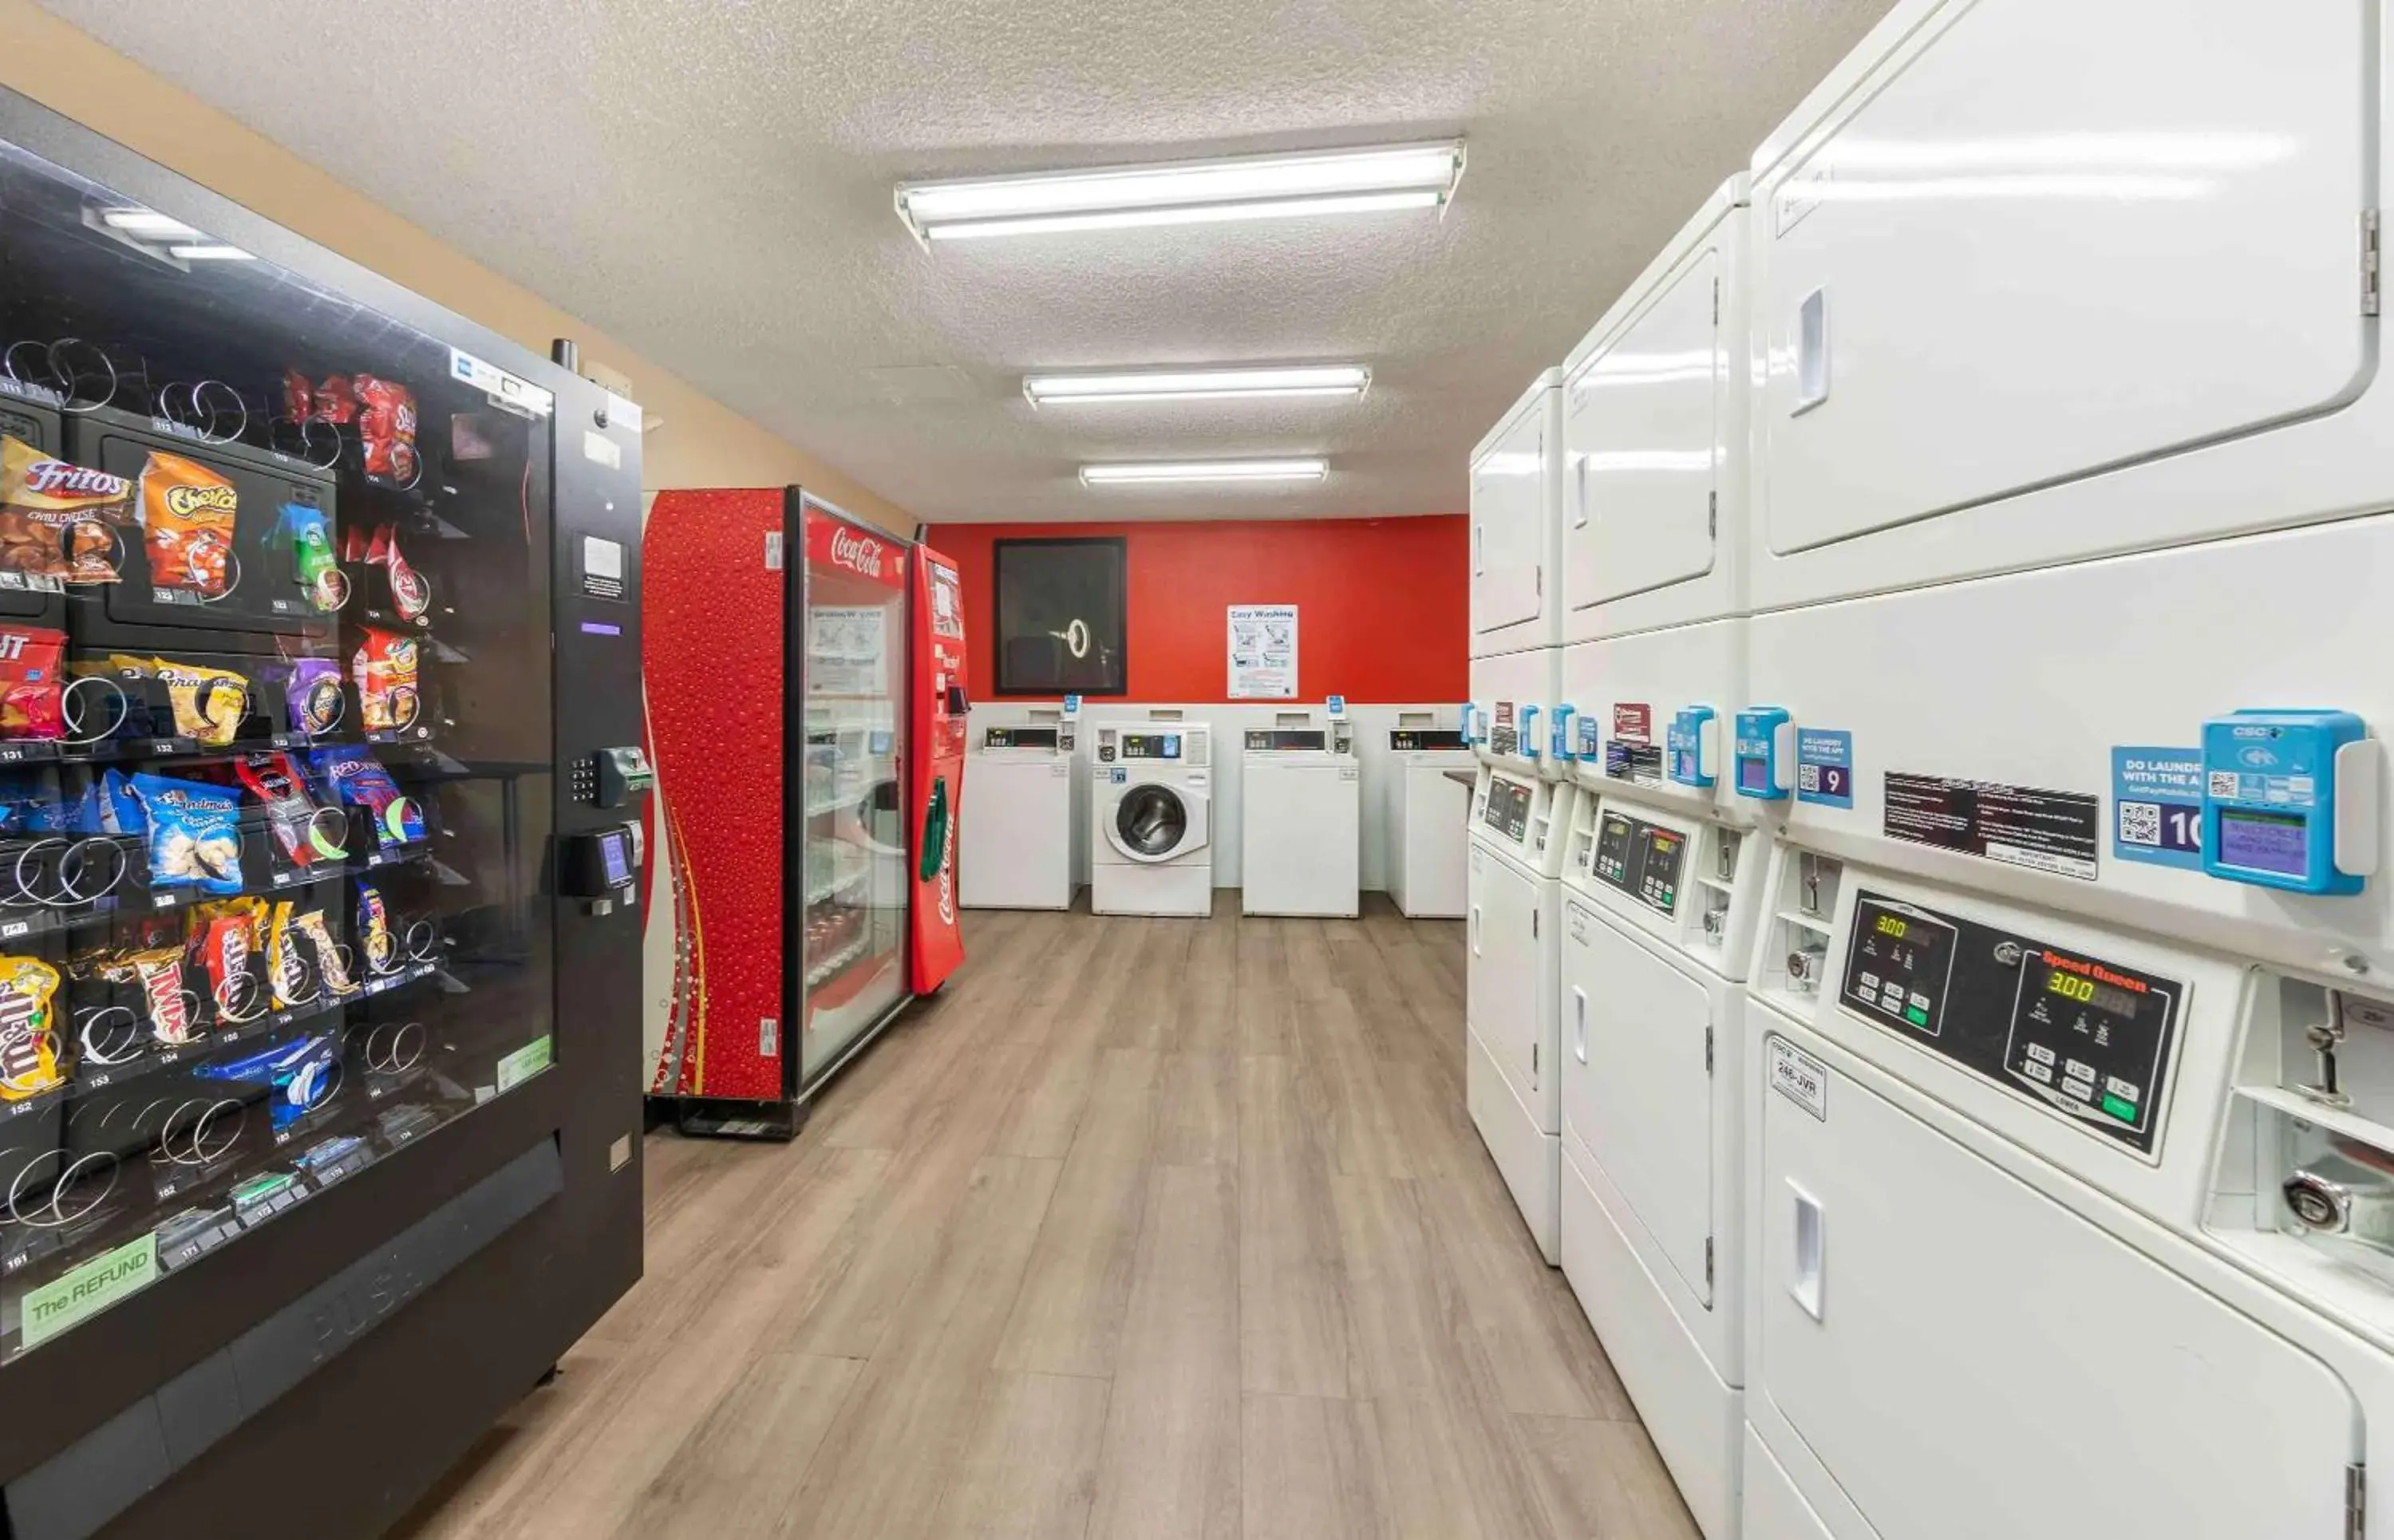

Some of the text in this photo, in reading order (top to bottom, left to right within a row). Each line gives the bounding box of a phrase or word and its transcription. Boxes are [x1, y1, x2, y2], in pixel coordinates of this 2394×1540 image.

[27, 460, 121, 495] Fritos
[2, 751, 22, 760] 131
[2126, 760, 2145, 770] DO
[1827, 770, 1840, 792] 9
[2123, 771, 2156, 783] WITH
[2159, 774, 2186, 785] THE
[1877, 915, 1906, 938] 3.00
[2042, 950, 2149, 994] Speed Queen
[2048, 972, 2095, 1003] 3.00
[147, 964, 185, 1035] TWIX
[11, 1102, 32, 1115] 152
[32, 1251, 148, 1321] The REFUND
